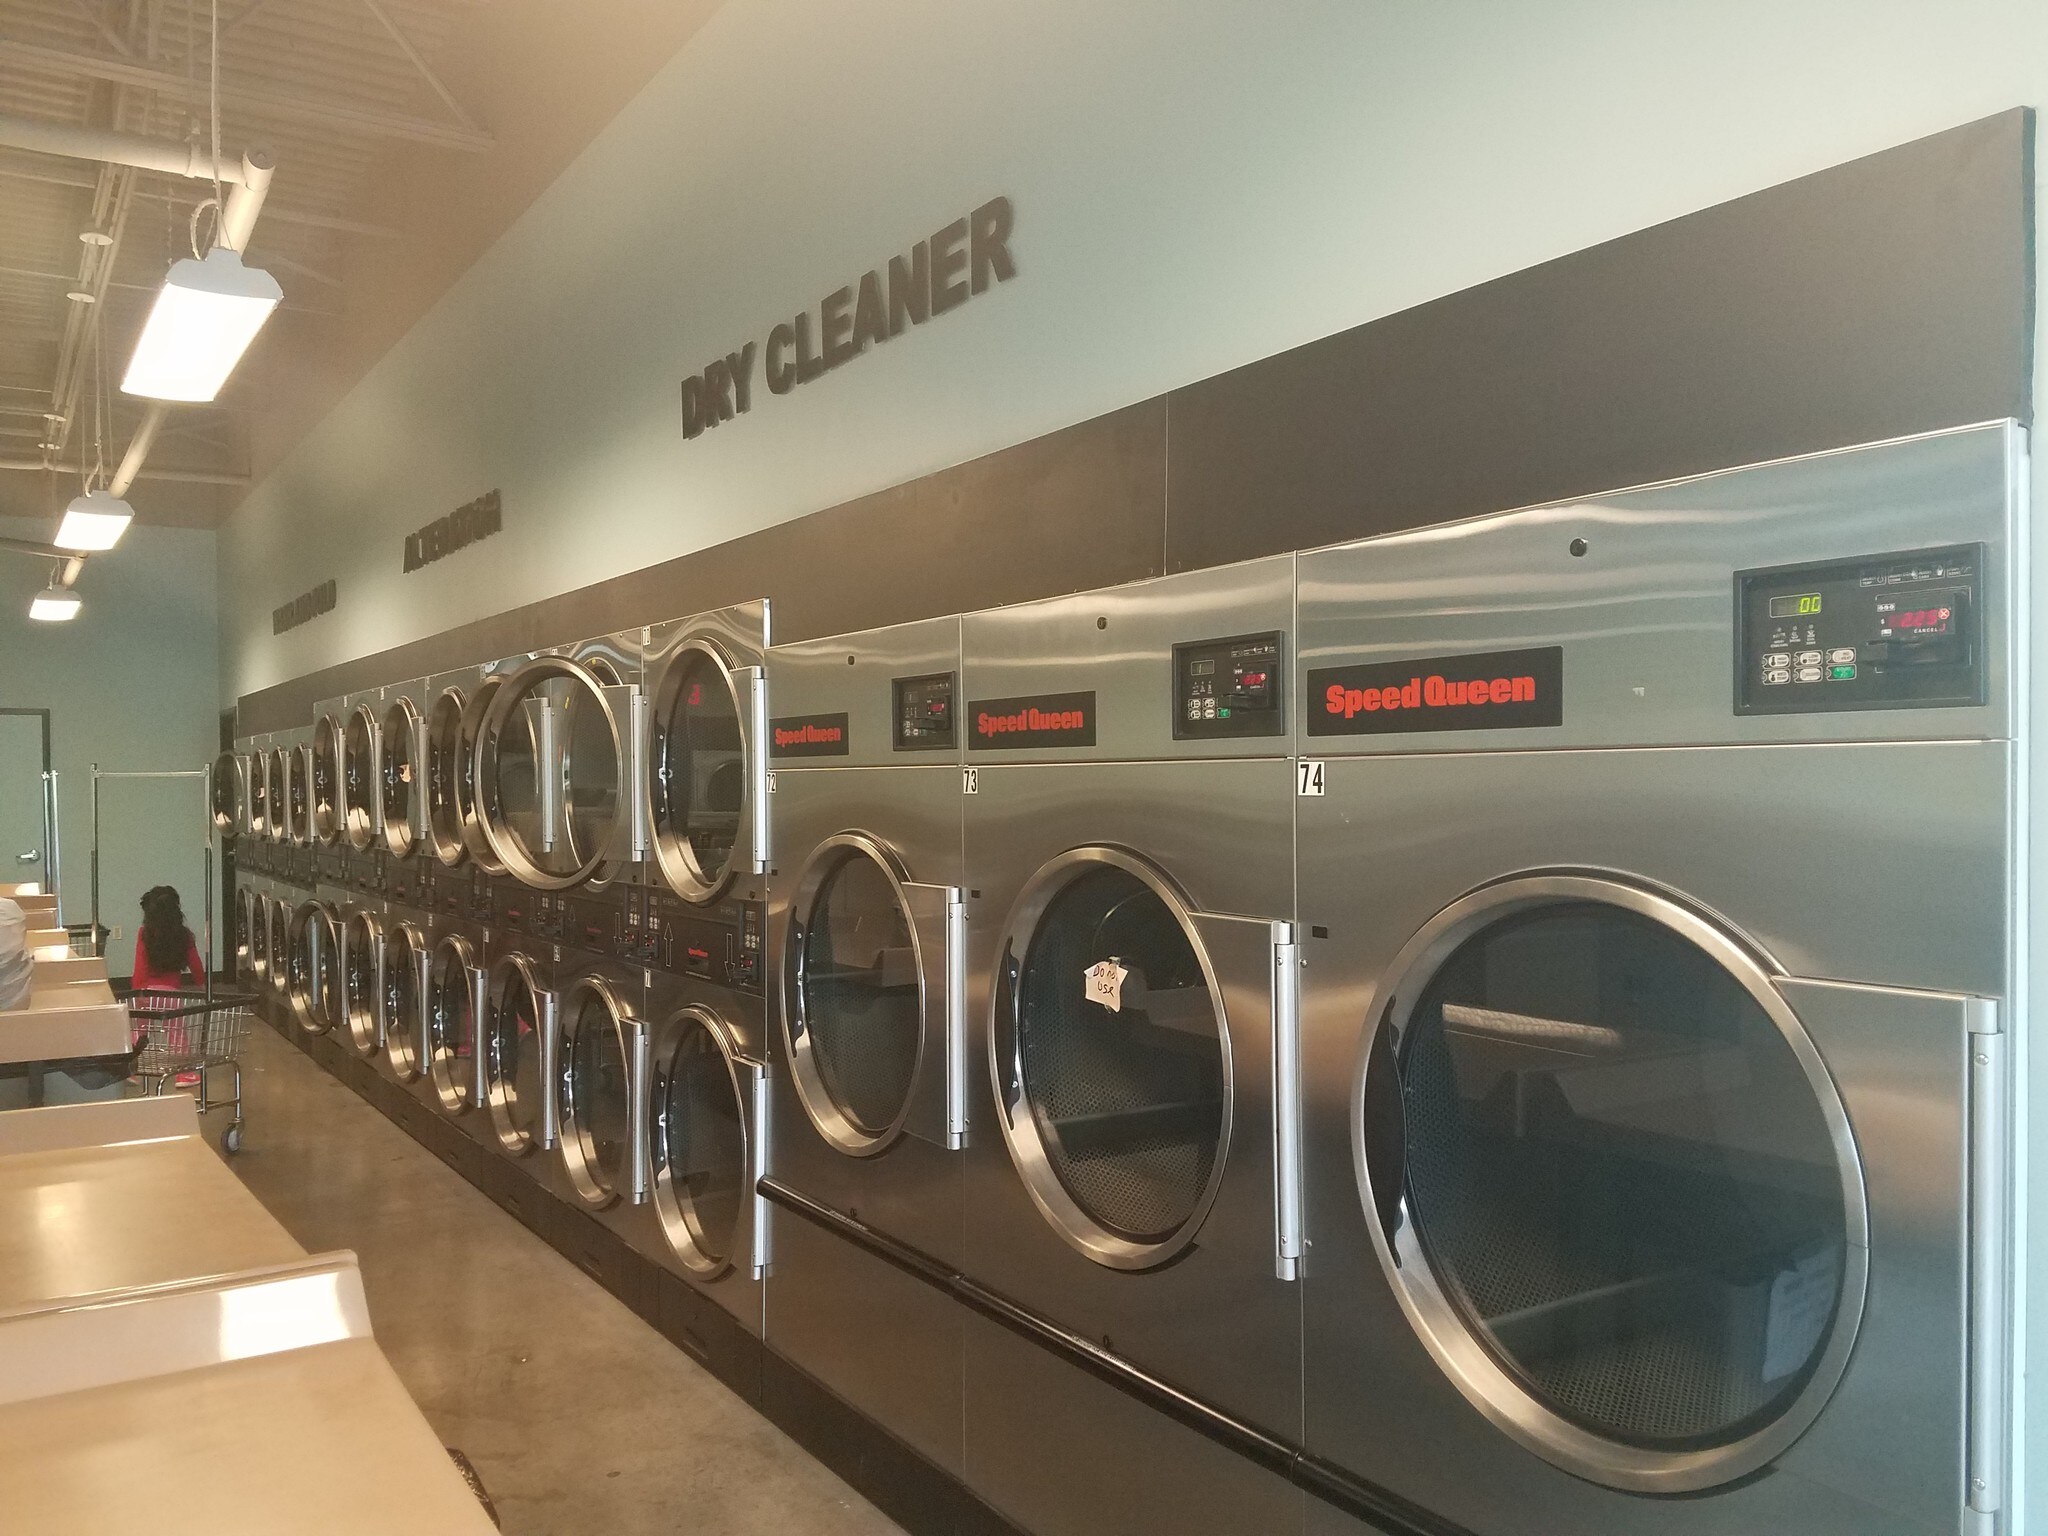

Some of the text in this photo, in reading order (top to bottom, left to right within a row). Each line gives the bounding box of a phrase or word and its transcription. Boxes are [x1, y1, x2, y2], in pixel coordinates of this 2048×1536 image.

[681, 195, 1017, 440] DRY CLEANER
[1326, 675, 1536, 719] Speed Queen
[775, 724, 842, 749] Speed Queen
[978, 707, 1084, 738] Speed Queen
[766, 773, 776, 792] 72
[963, 769, 977, 793] 73
[1300, 763, 1323, 794] 74
